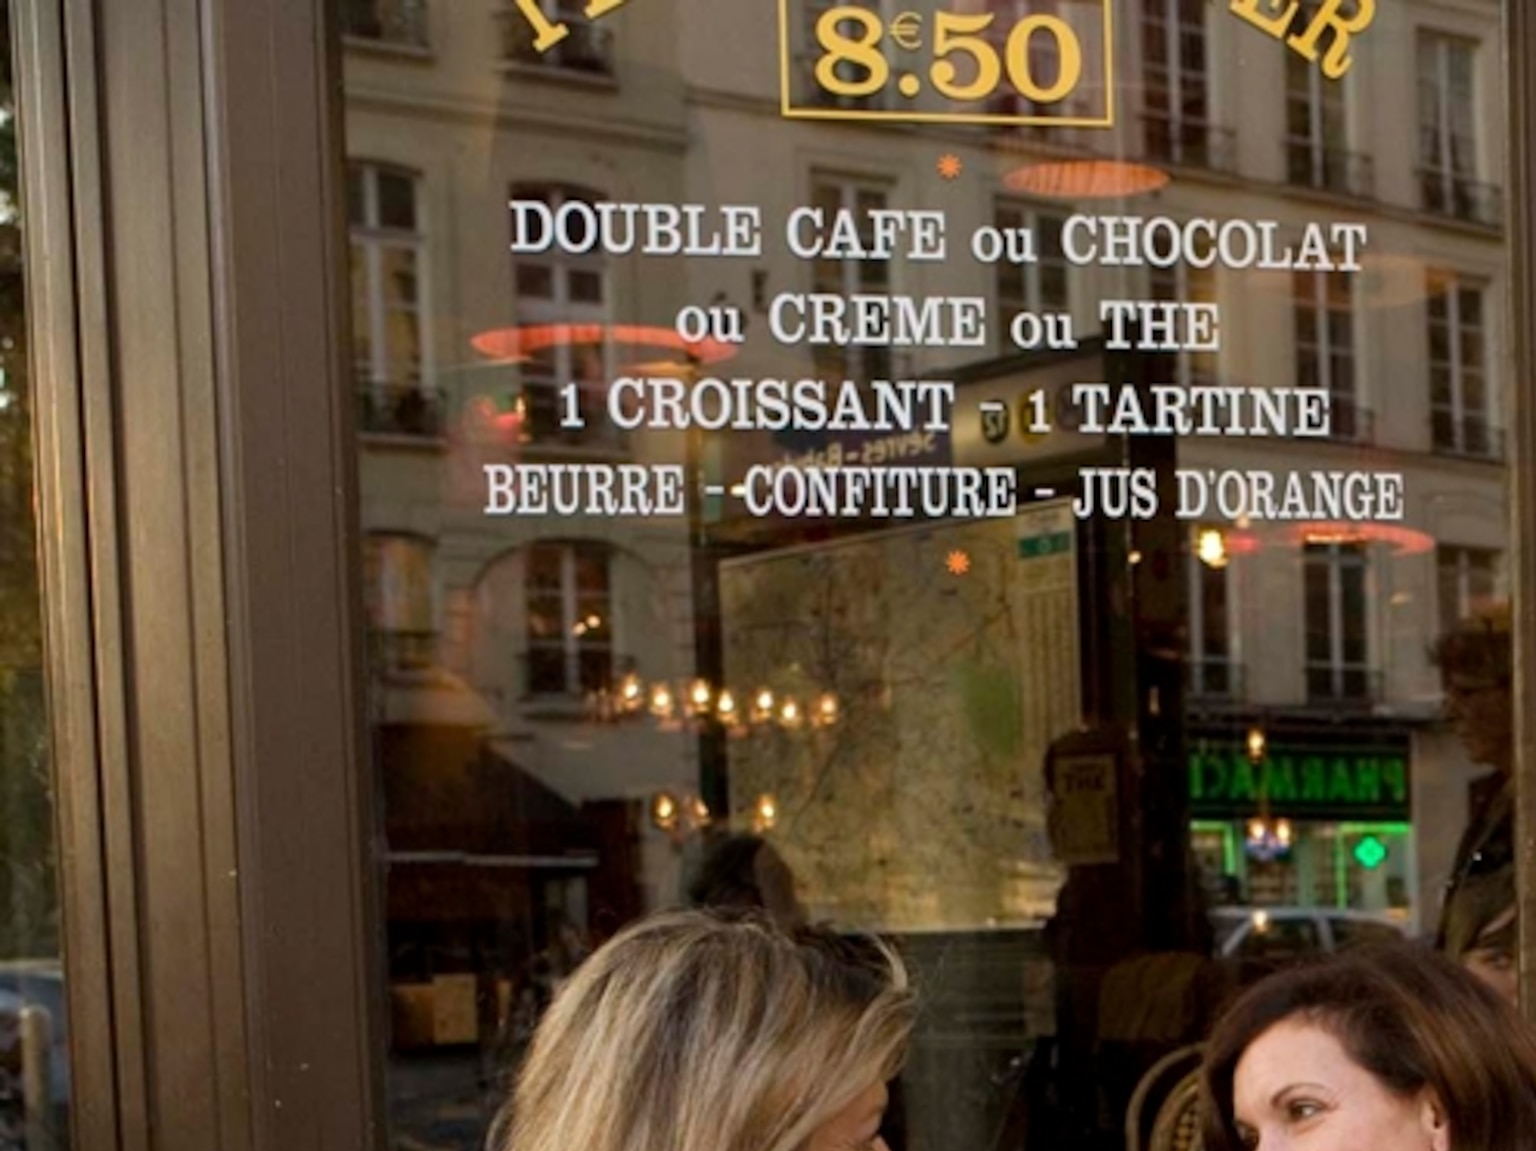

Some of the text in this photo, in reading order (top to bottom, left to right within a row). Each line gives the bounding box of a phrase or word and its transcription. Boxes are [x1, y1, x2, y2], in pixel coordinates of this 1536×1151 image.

[509, 200, 1368, 272] DOUBLE CAFE ou CHOCOLAT
[675, 292, 1221, 352] ou CREME ou THE
[558, 382, 584, 428] 1
[606, 376, 955, 431] CROISSANT
[1027, 388, 1053, 434] 1
[1071, 383, 1331, 437] TARTINE
[482, 463, 686, 516] BEURRE
[743, 464, 1017, 519] CONFITURE
[1072, 468, 1158, 519] JUS
[1175, 469, 1405, 523] D'ORANGE
